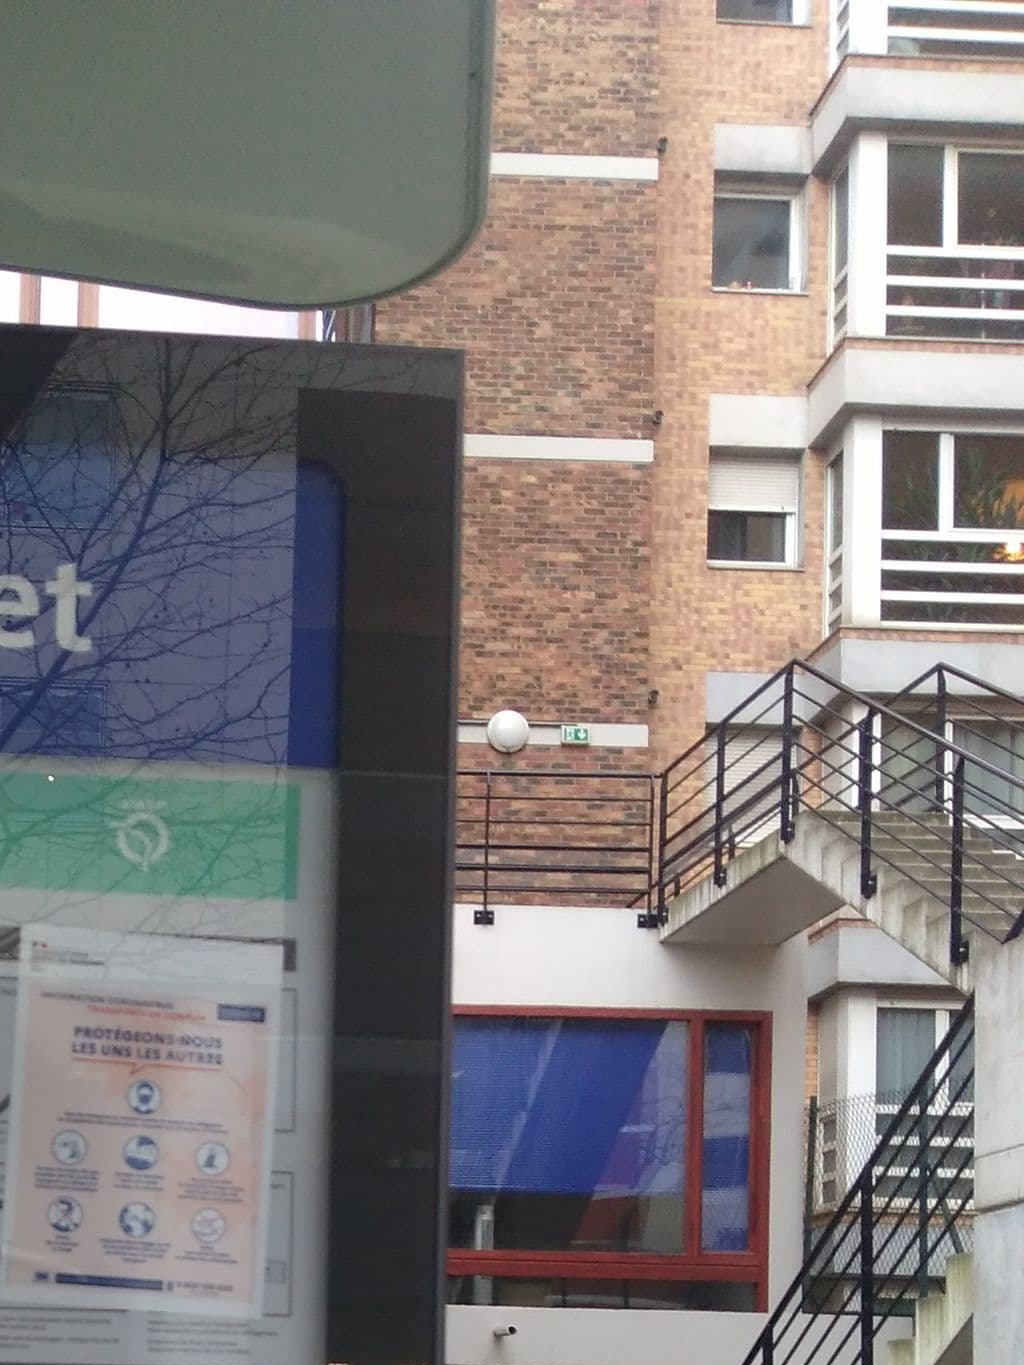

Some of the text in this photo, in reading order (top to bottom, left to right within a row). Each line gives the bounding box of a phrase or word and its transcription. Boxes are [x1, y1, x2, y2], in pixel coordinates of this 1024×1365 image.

[72, 1041, 223, 1065] LES UNS LES AUTRES
